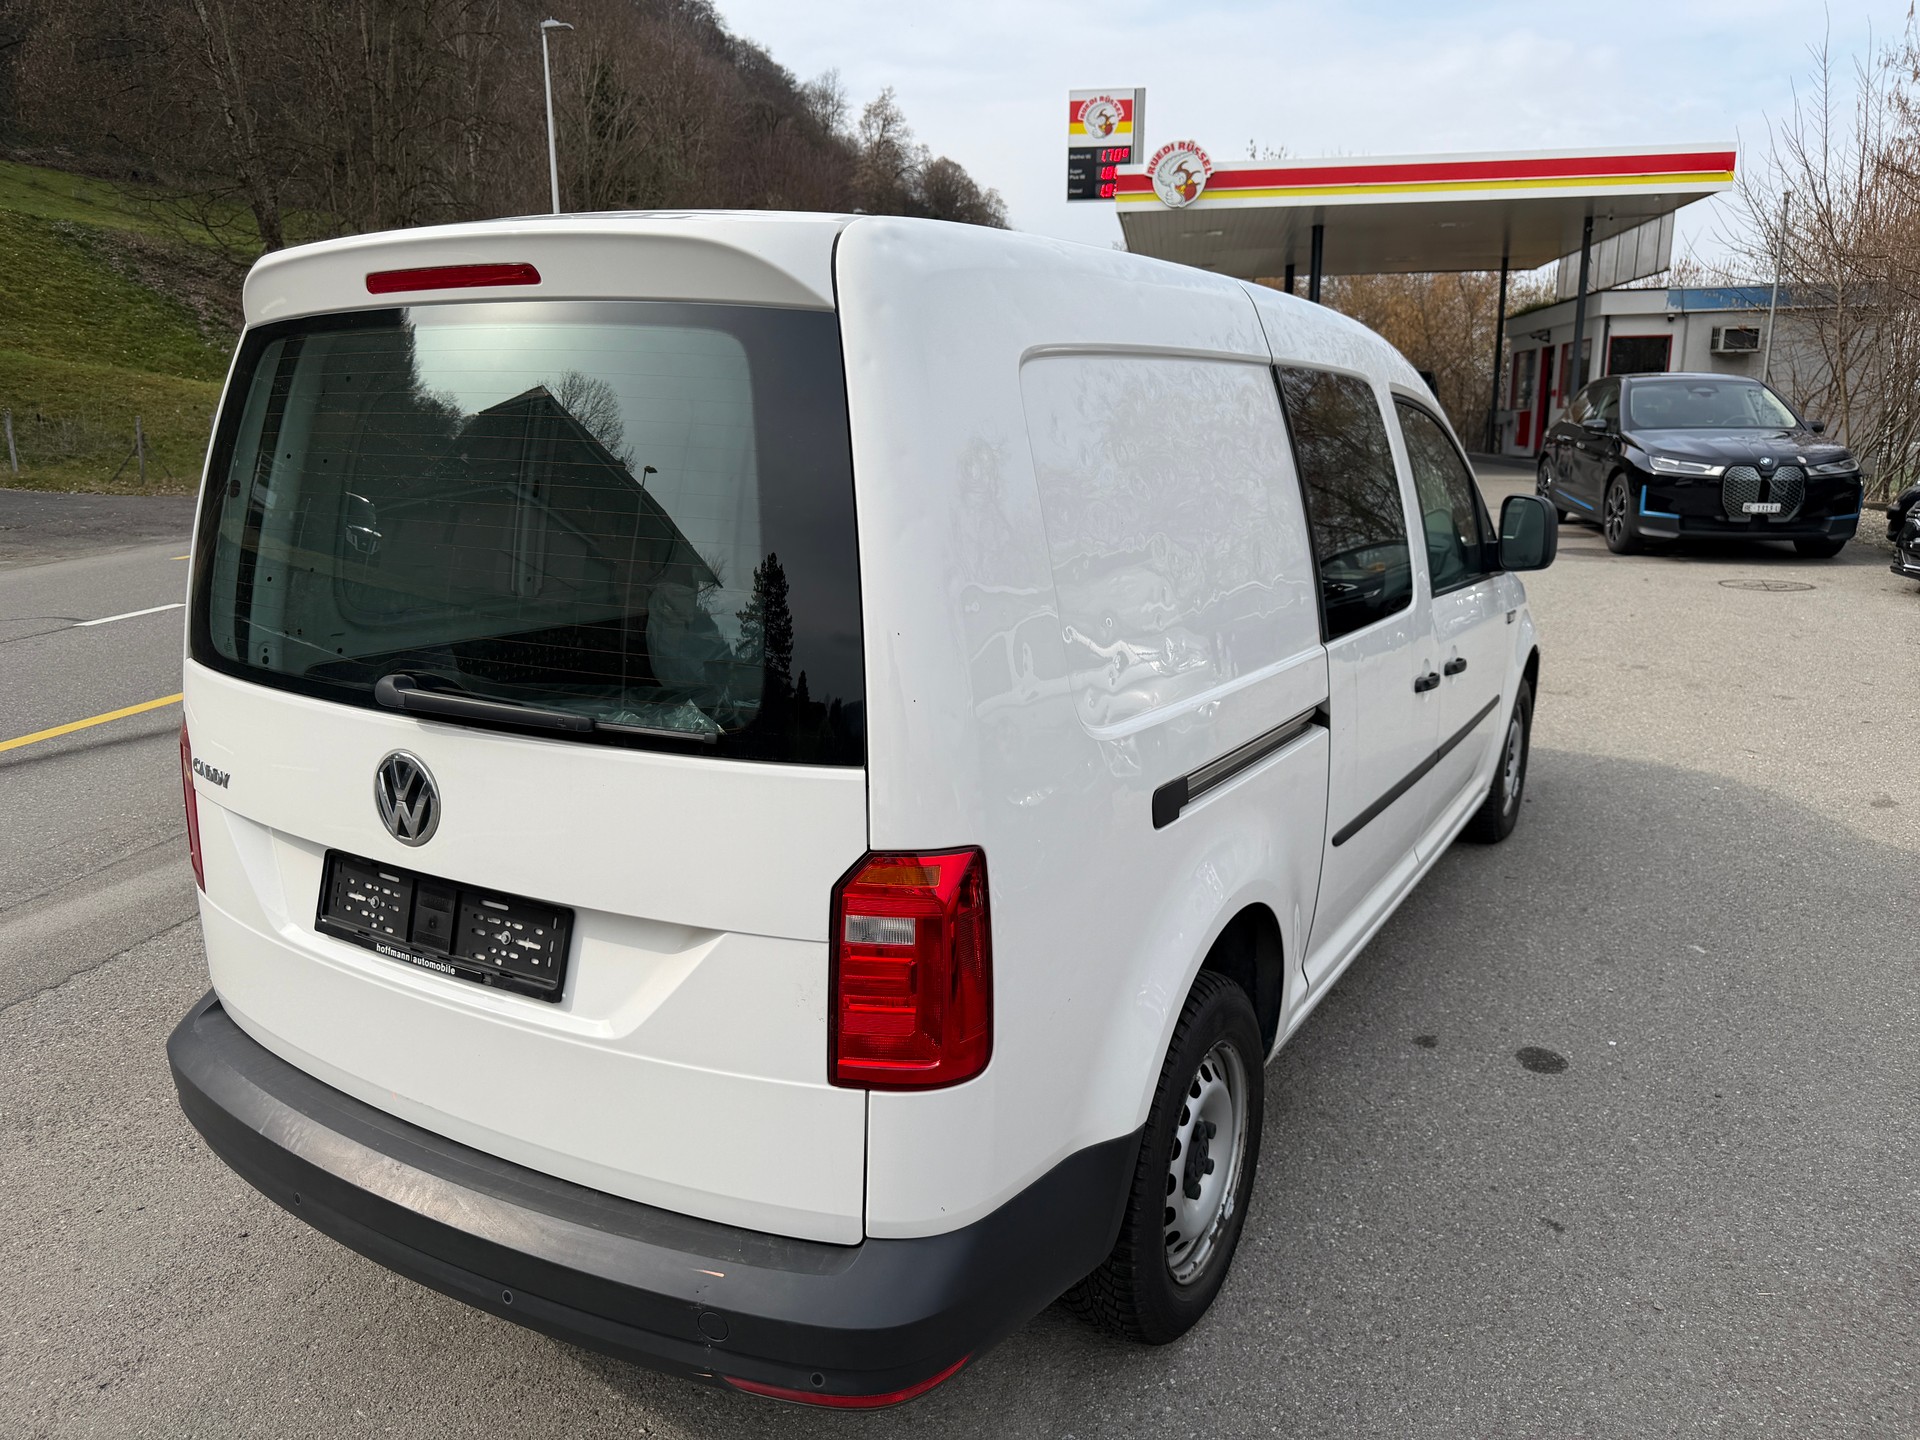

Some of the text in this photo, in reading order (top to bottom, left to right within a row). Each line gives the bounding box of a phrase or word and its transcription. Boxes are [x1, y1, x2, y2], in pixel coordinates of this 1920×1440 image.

[1080, 96, 1098, 119] RUEDI
[1147, 139, 1212, 176] RUEDI RÜSSEL
[193, 757, 231, 789] CADDY
[376, 943, 456, 976] hoffmann automobile
